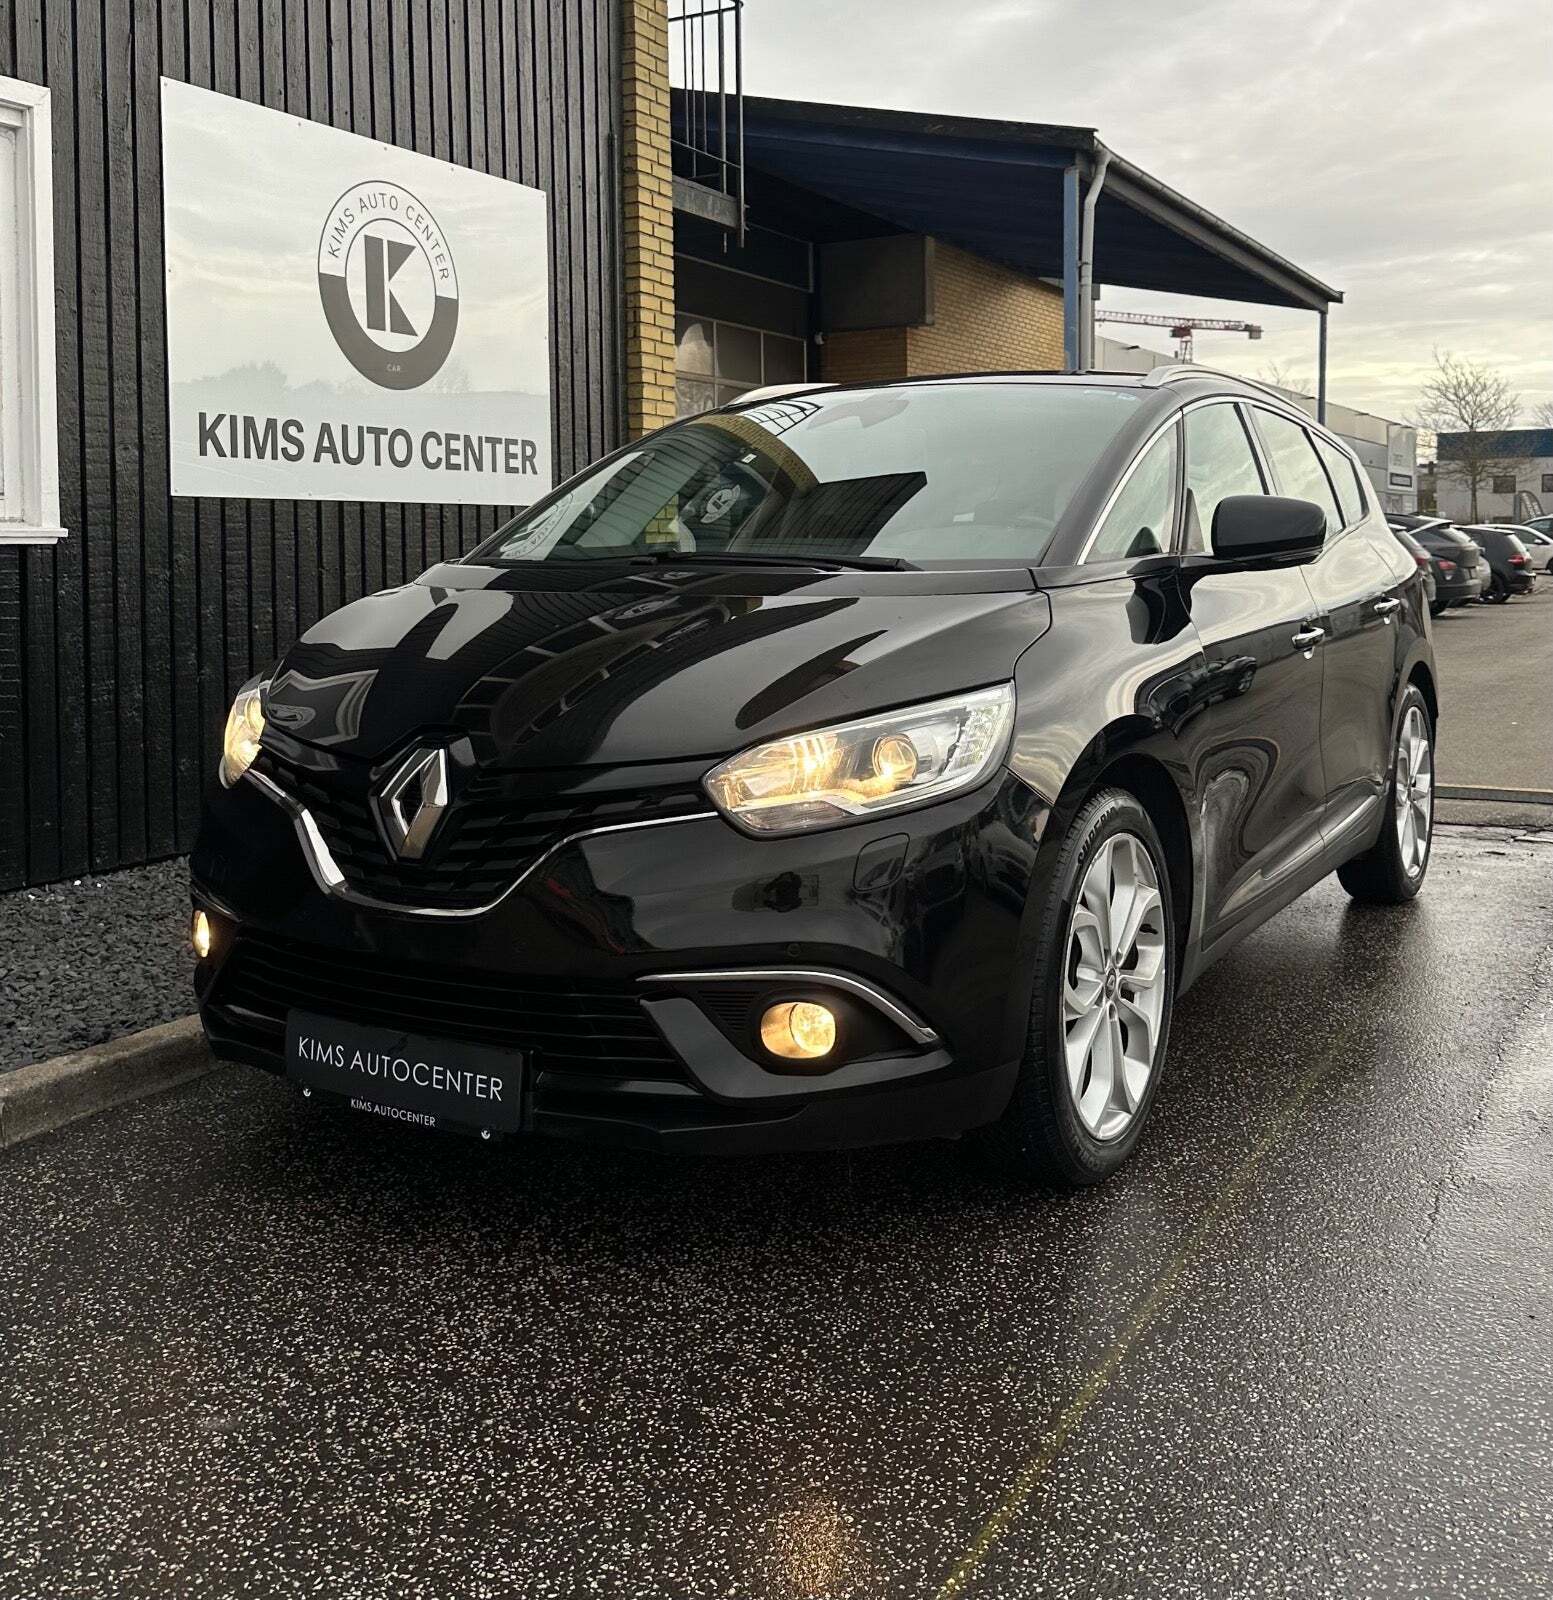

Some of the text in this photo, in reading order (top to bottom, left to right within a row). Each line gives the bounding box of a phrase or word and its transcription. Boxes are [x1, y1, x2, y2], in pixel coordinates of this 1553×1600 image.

[328, 192, 450, 281] KIMS AUTO CENTER
[364, 234, 419, 337] K
[198, 411, 539, 475] KIMS AUTO CENTER
[298, 1036, 503, 1102] KIMS AUTOCENTER
[350, 1098, 436, 1128] KIMS AUTOCENTER
